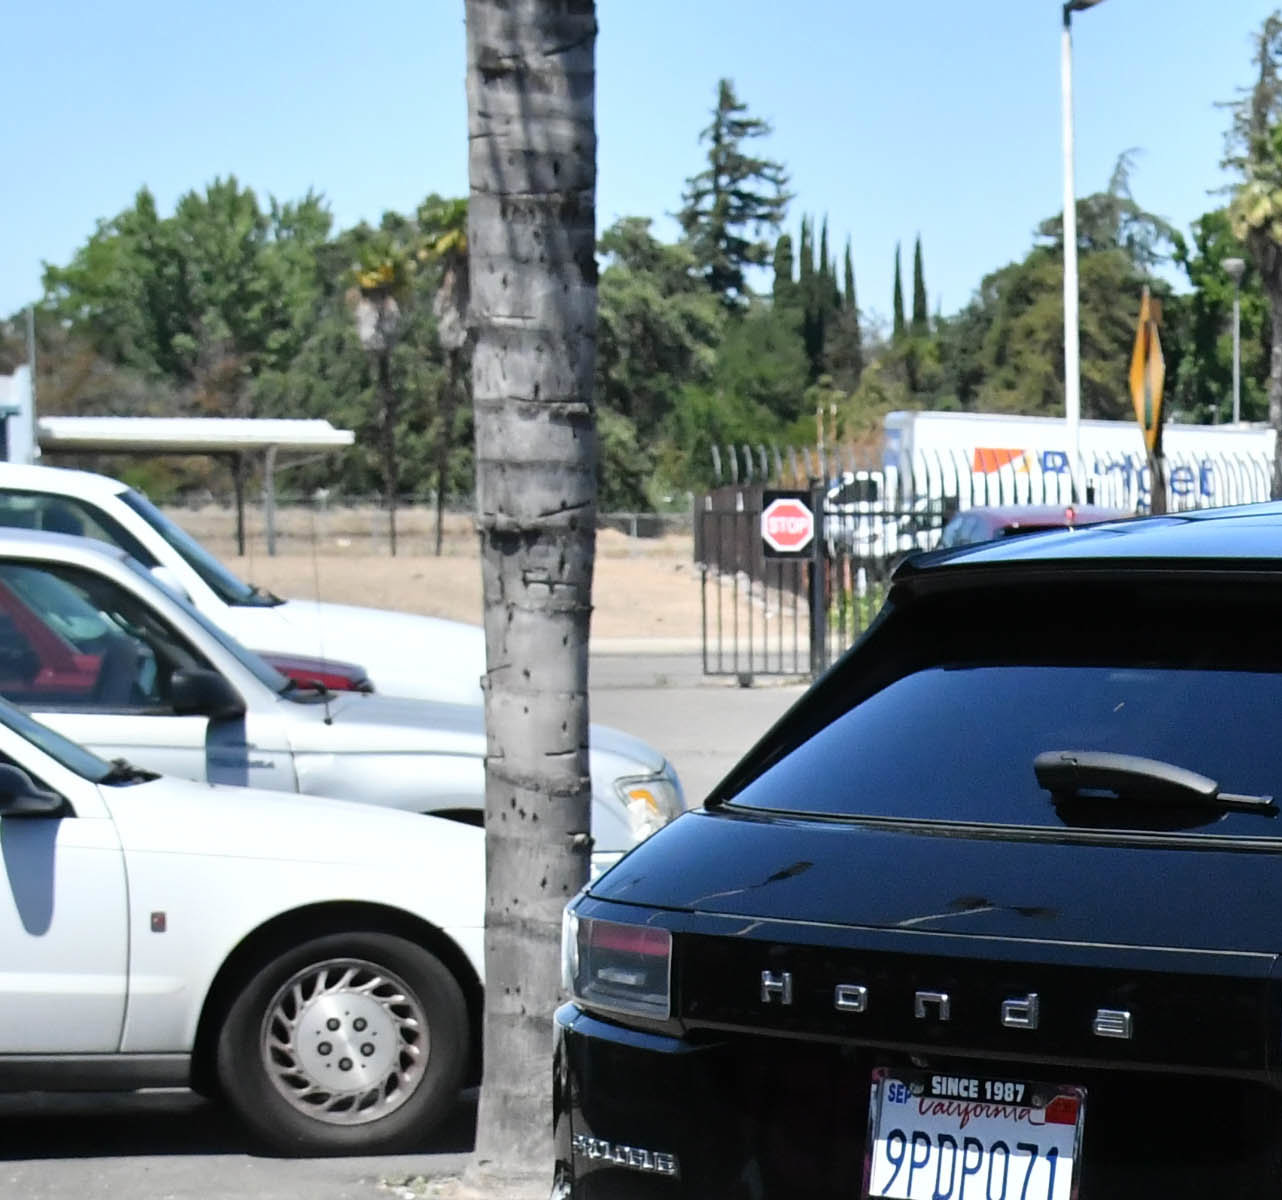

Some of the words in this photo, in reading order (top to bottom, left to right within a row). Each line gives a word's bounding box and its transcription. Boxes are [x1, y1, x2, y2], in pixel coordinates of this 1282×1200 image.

[768, 516, 808, 534] STOP
[931, 1075, 979, 1099] SINCE
[985, 1080, 1025, 1103] 1987
